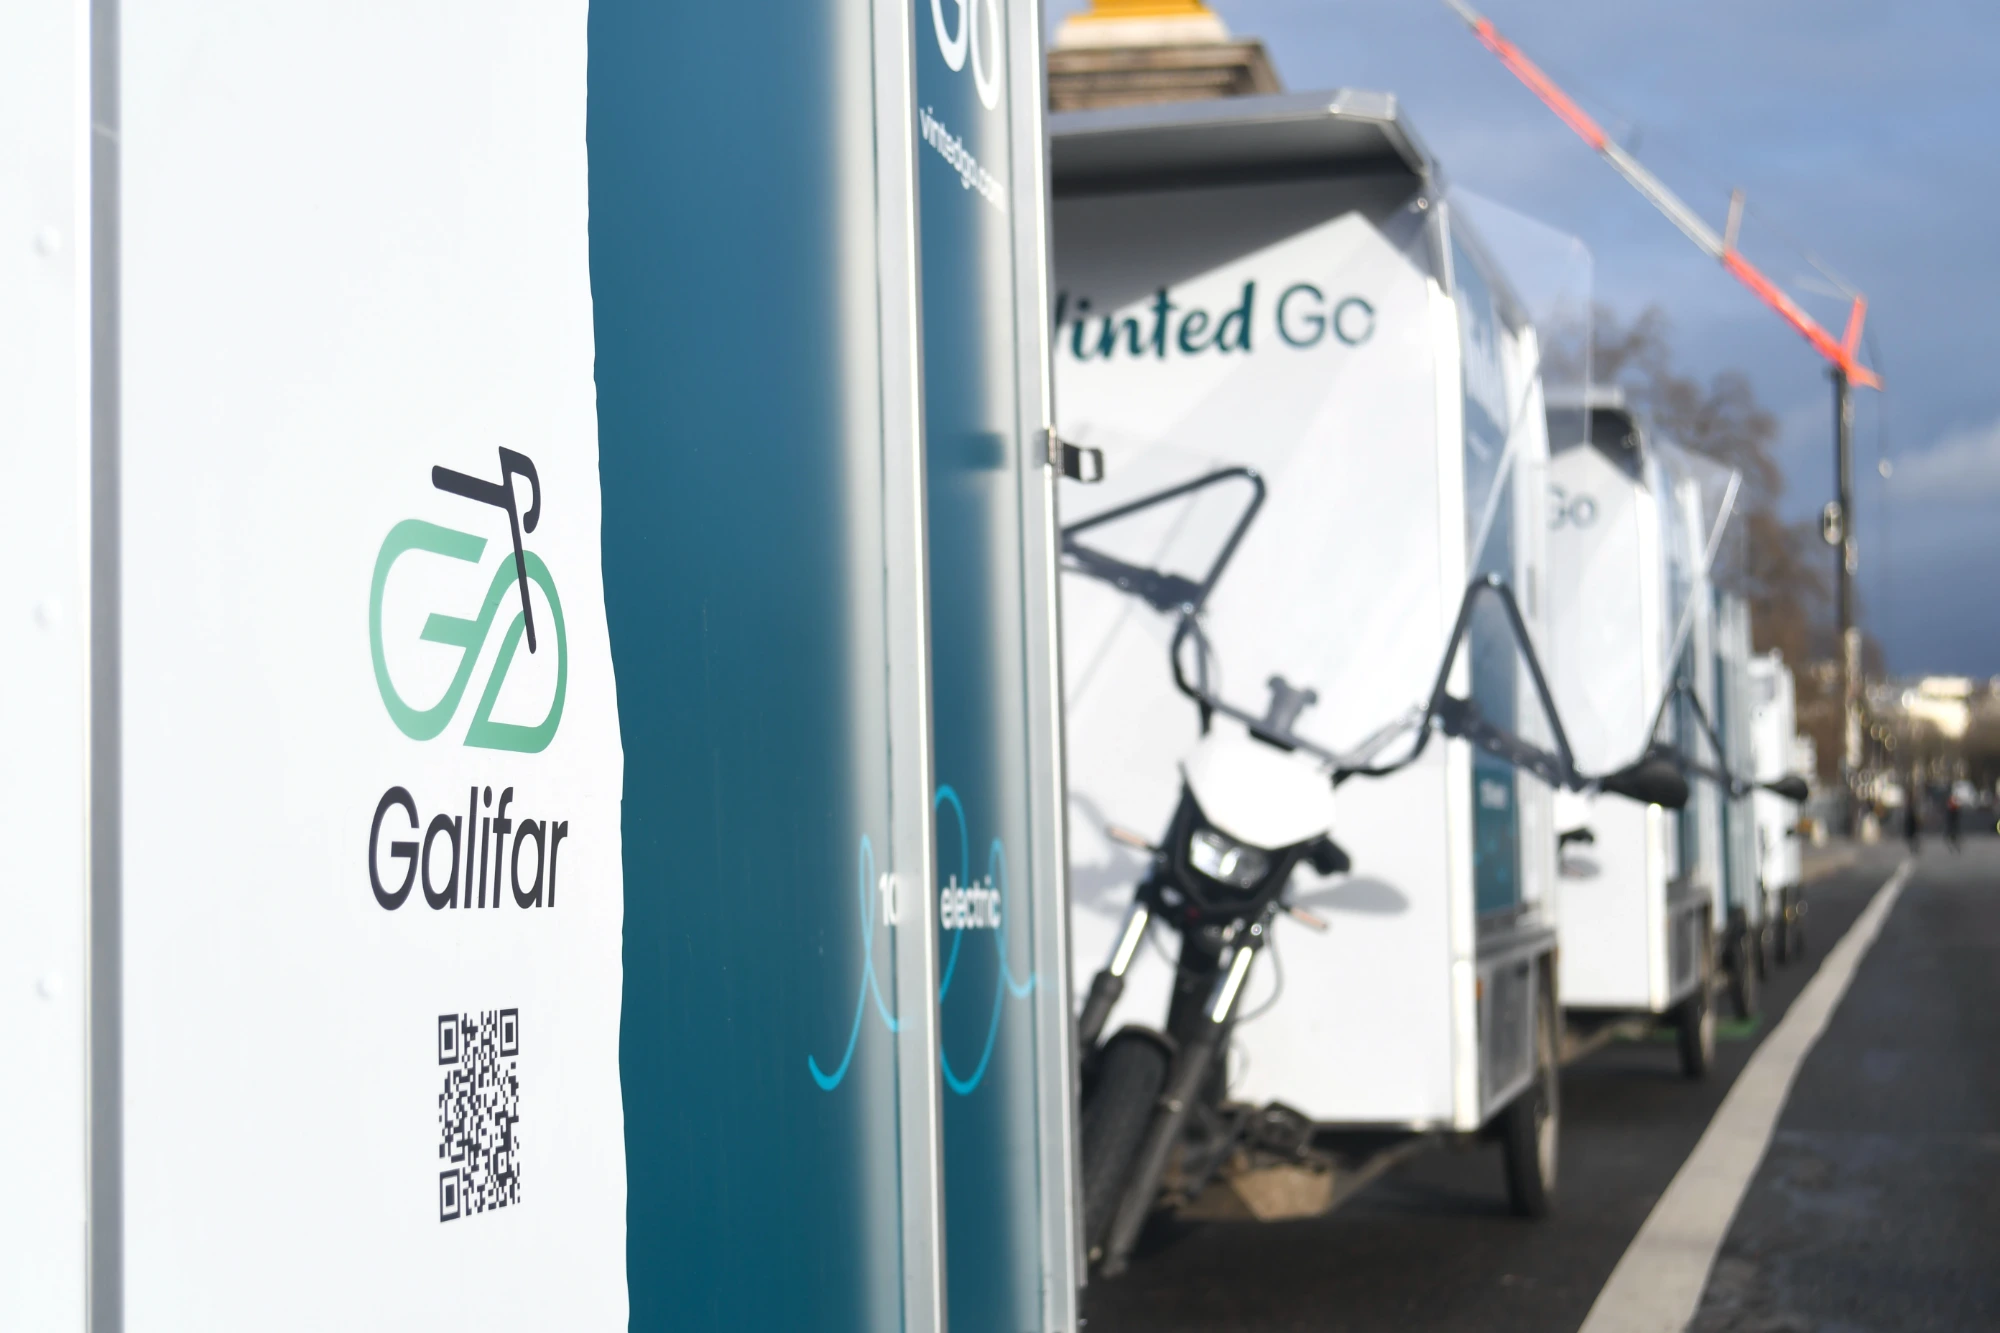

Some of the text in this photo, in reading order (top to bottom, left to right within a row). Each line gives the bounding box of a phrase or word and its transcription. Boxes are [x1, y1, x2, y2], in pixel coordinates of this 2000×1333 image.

[919, 106, 1007, 214] vintedgo.co
[1276, 282, 1376, 350] Go
[368, 785, 568, 911] Galifar
[941, 873, 1001, 930] electric
